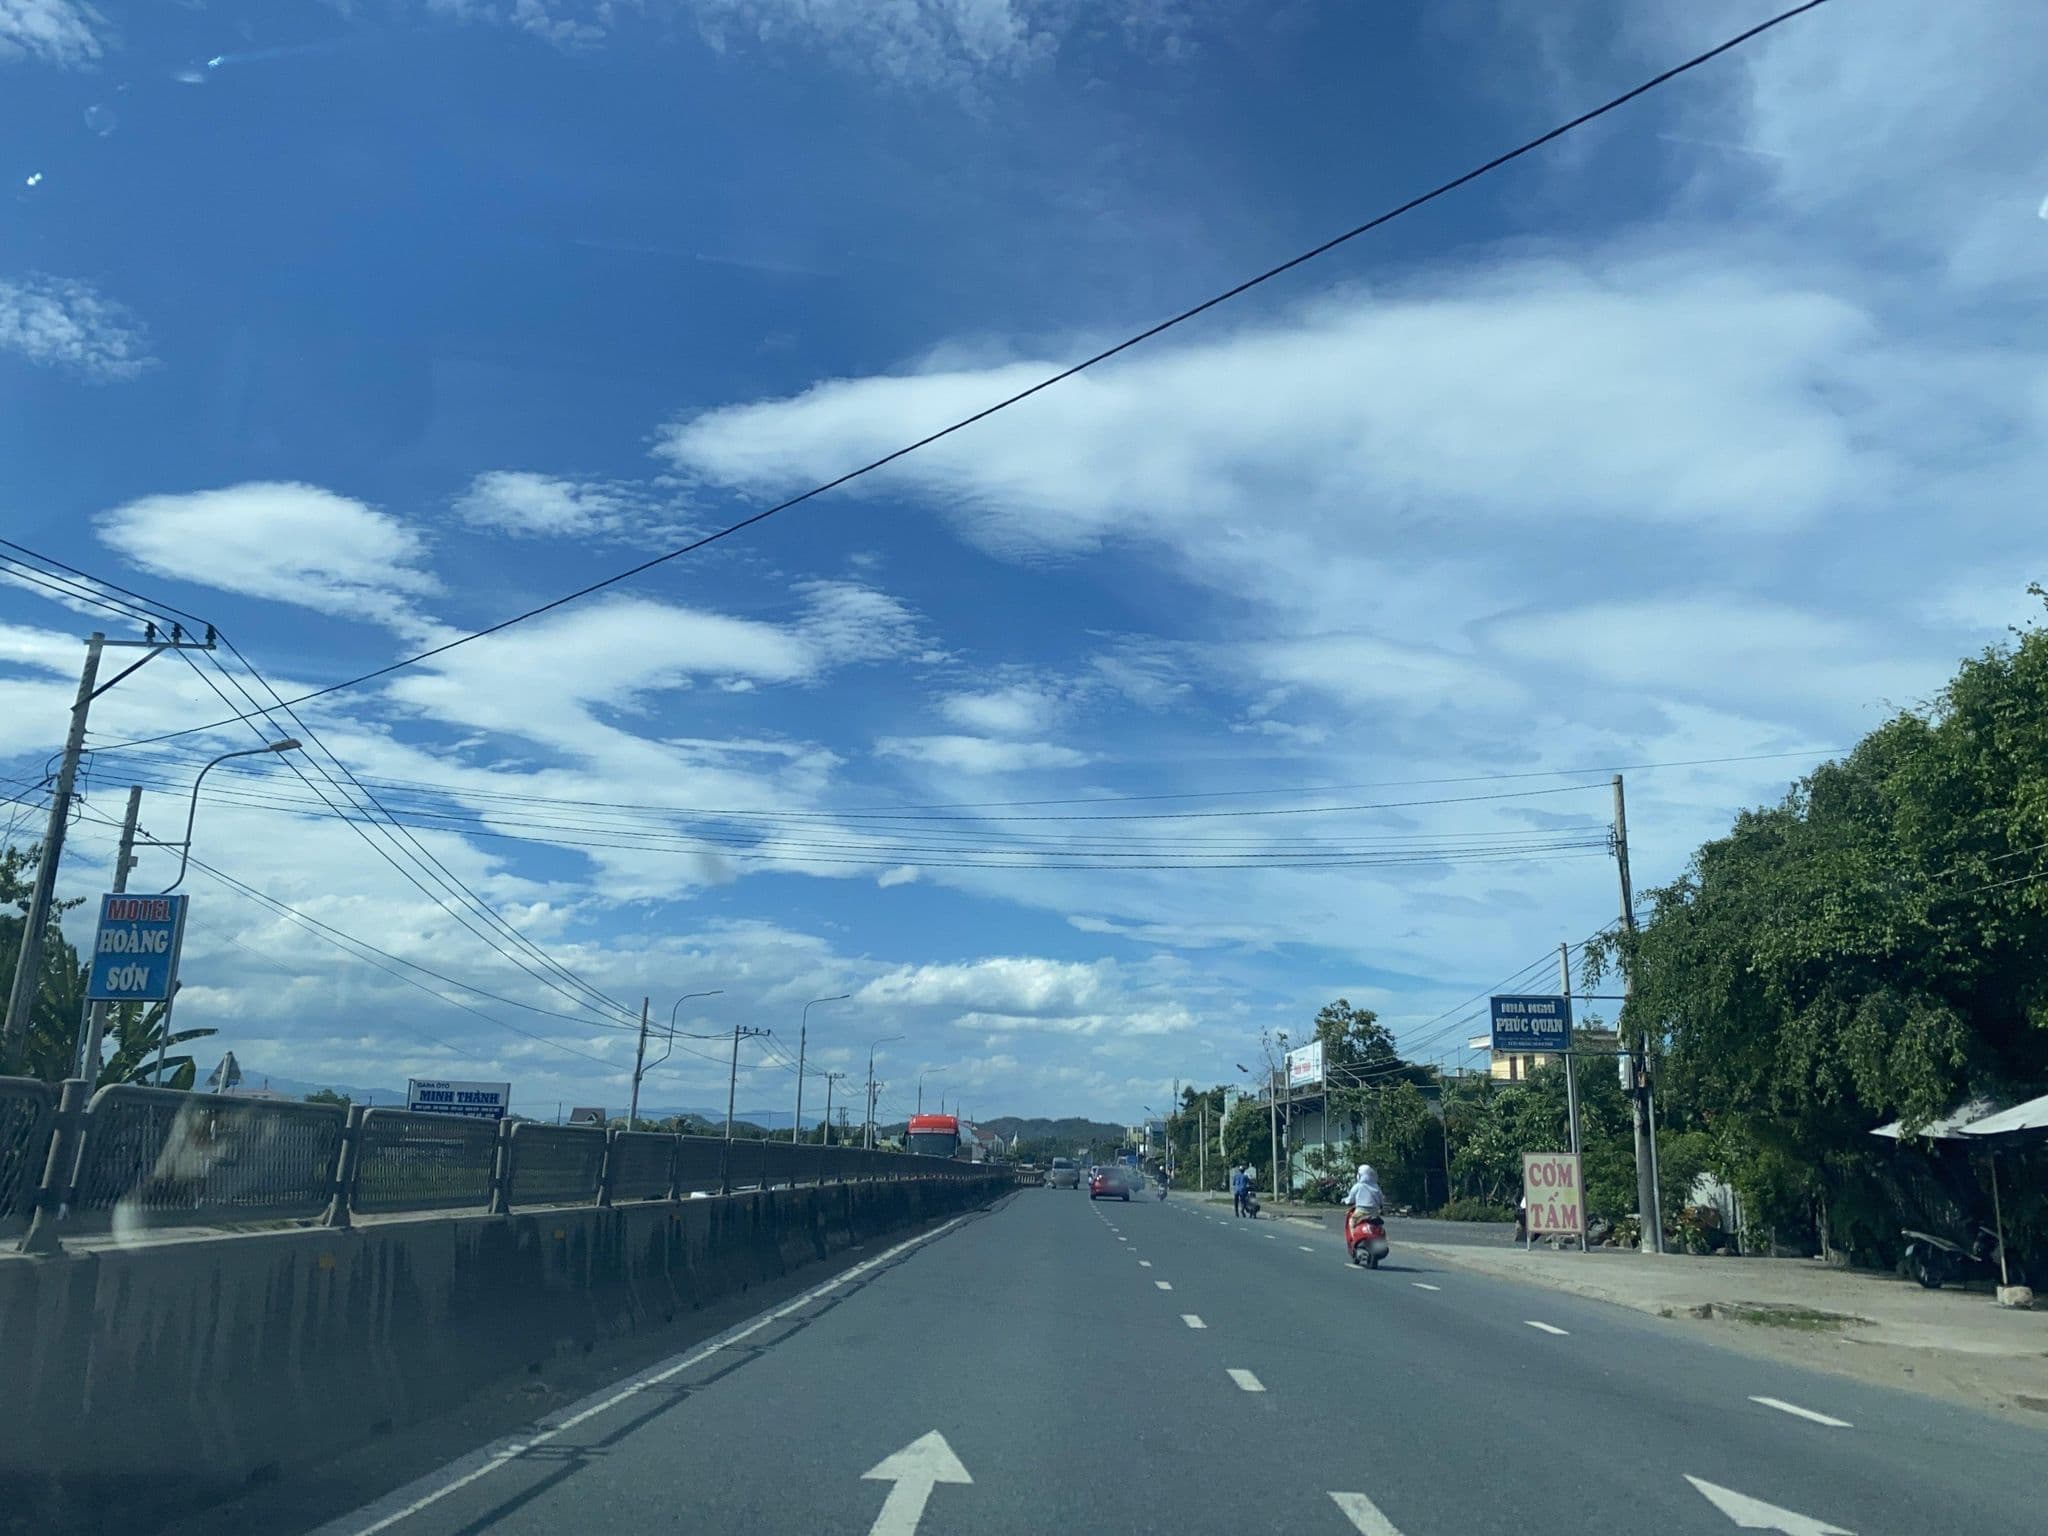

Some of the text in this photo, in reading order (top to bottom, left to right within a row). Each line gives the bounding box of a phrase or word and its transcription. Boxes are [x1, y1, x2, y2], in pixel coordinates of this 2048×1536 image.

[107, 899, 171, 921] MOTEL
[98, 923, 169, 953] HOÀNG
[105, 962, 149, 991] SƠN
[1501, 1002, 1526, 1013] NHÀ
[1495, 1015, 1563, 1036] PHÚC QUAN
[420, 1089, 500, 1104] MINH THÀNH
[1528, 1158, 1573, 1188] CƠM
[1530, 1191, 1578, 1229] TẤM
